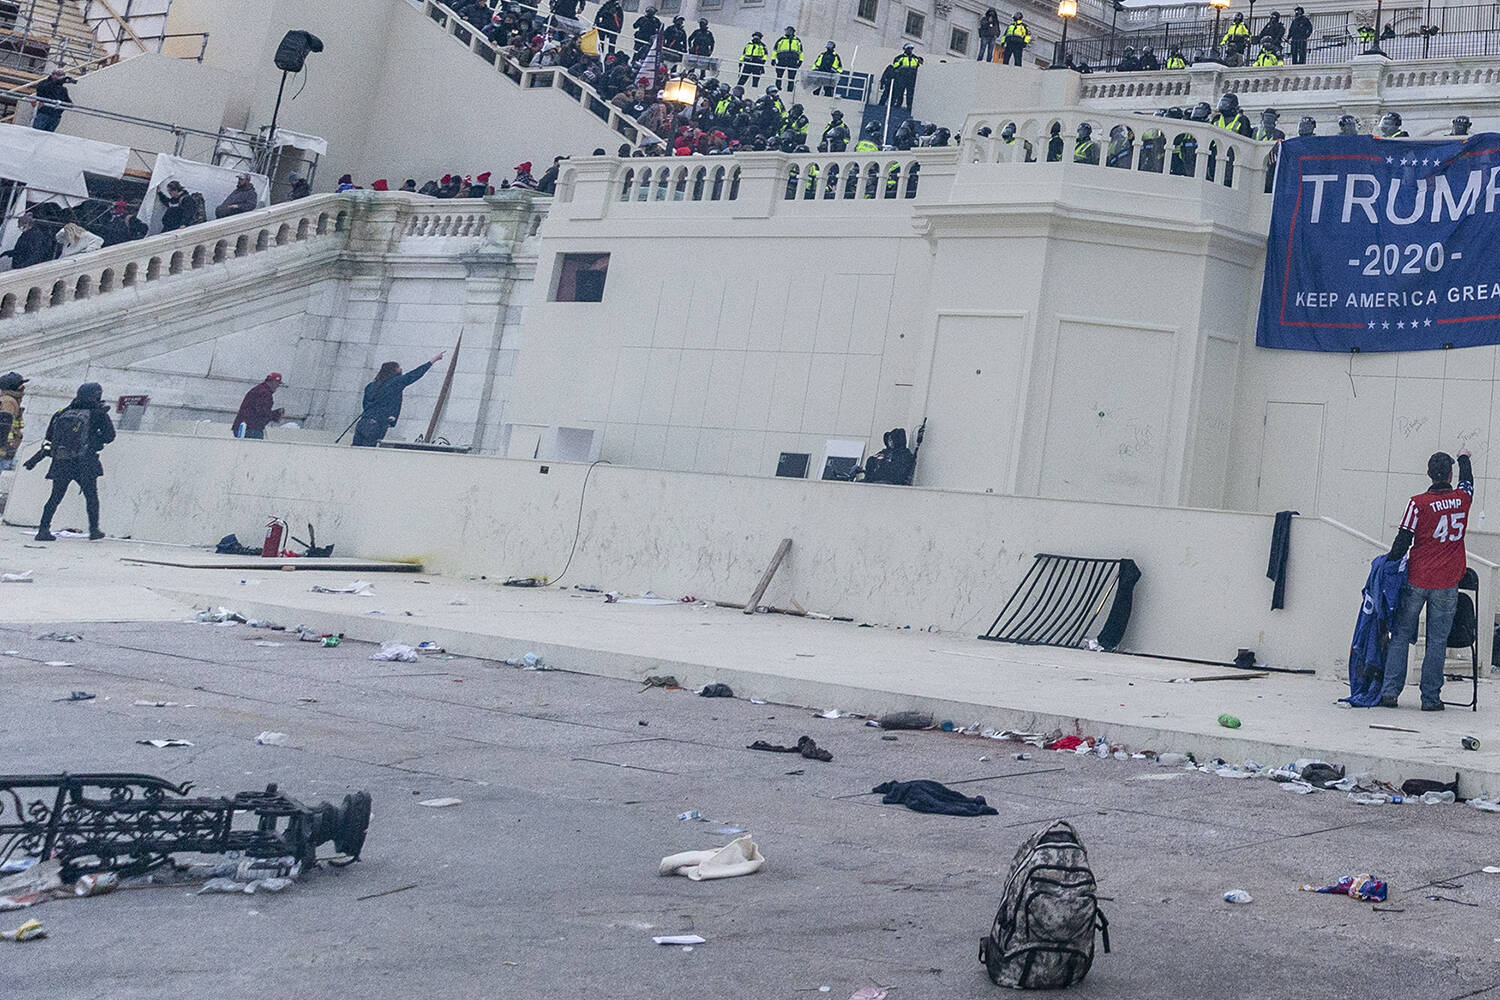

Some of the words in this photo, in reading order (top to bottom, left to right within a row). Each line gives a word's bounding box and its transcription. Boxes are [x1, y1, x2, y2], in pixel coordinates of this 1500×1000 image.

[1295, 291, 1339, 307] KEEP
[1346, 289, 1437, 308] AMERICA
[1430, 498, 1462, 513] TRUMP
[1432, 512, 1466, 543] 45
